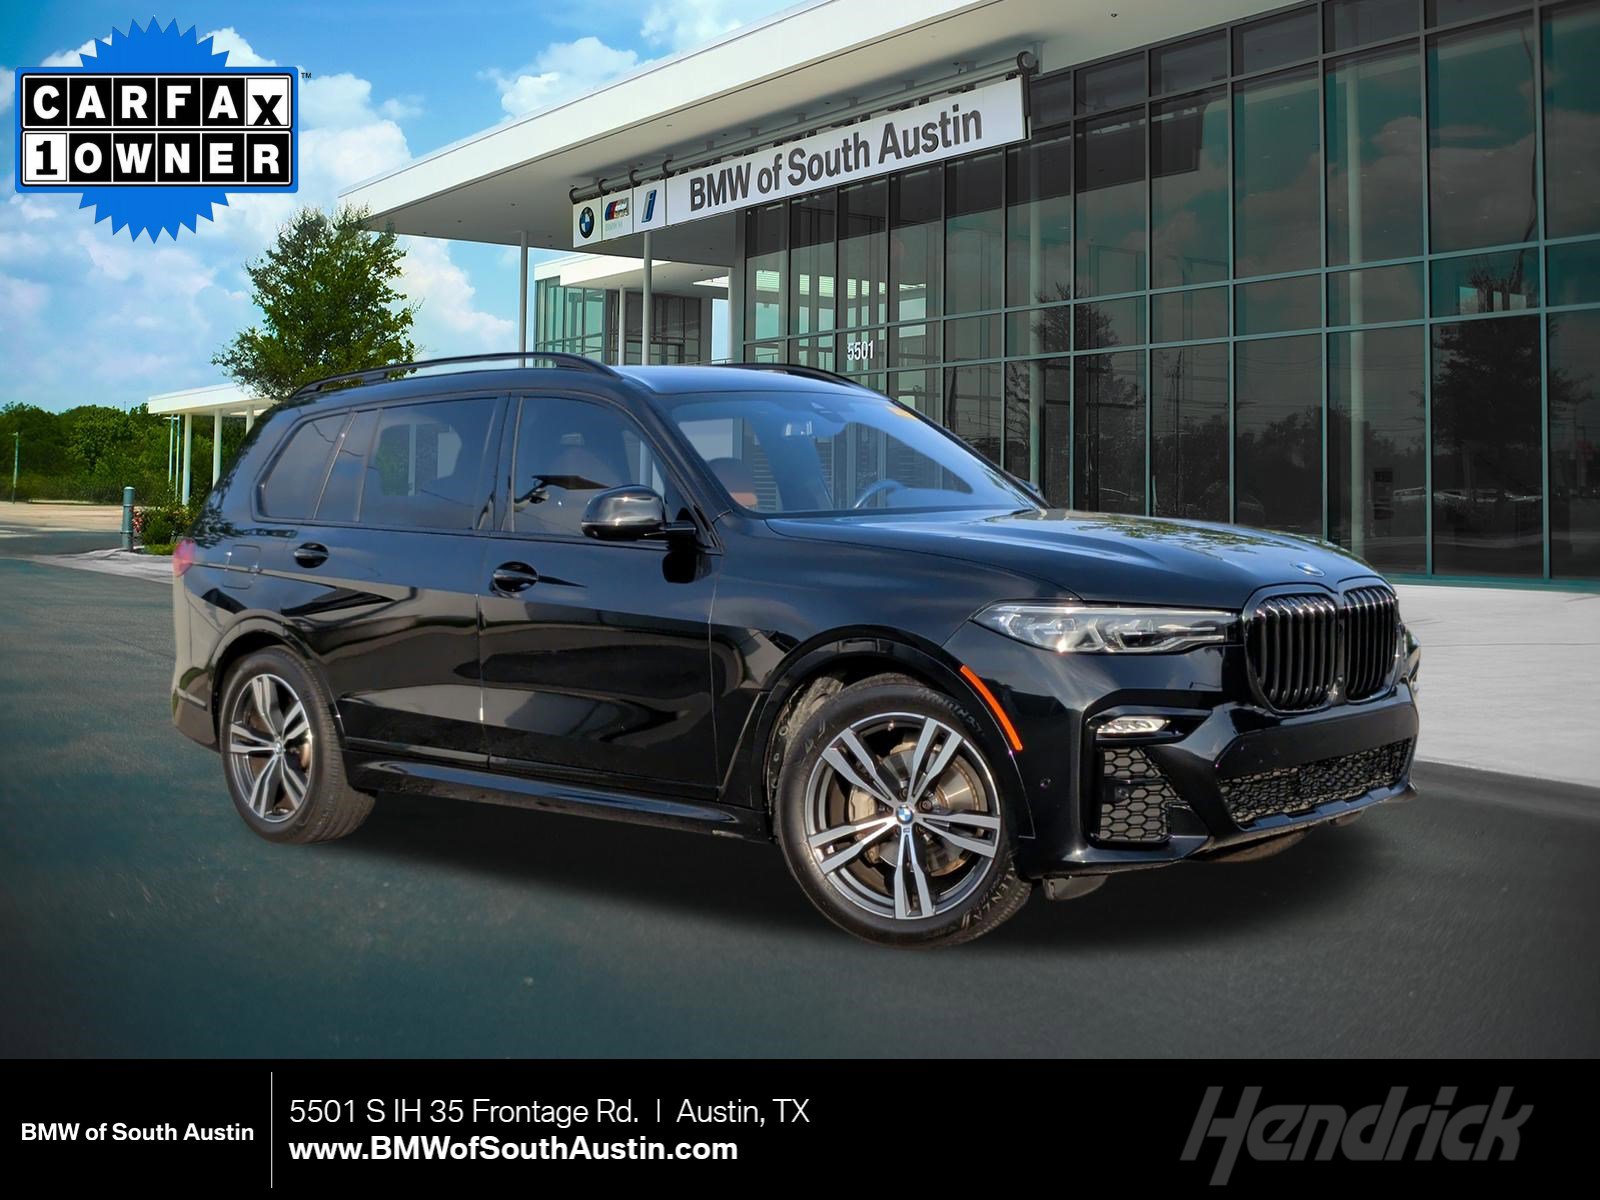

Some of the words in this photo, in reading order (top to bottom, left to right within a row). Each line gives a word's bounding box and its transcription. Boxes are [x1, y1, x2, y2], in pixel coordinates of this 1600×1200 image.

[690, 162, 752, 212] BMW
[757, 153, 783, 194] of
[787, 131, 871, 186] South
[878, 103, 983, 164] Austin
[847, 339, 874, 361] 5501
